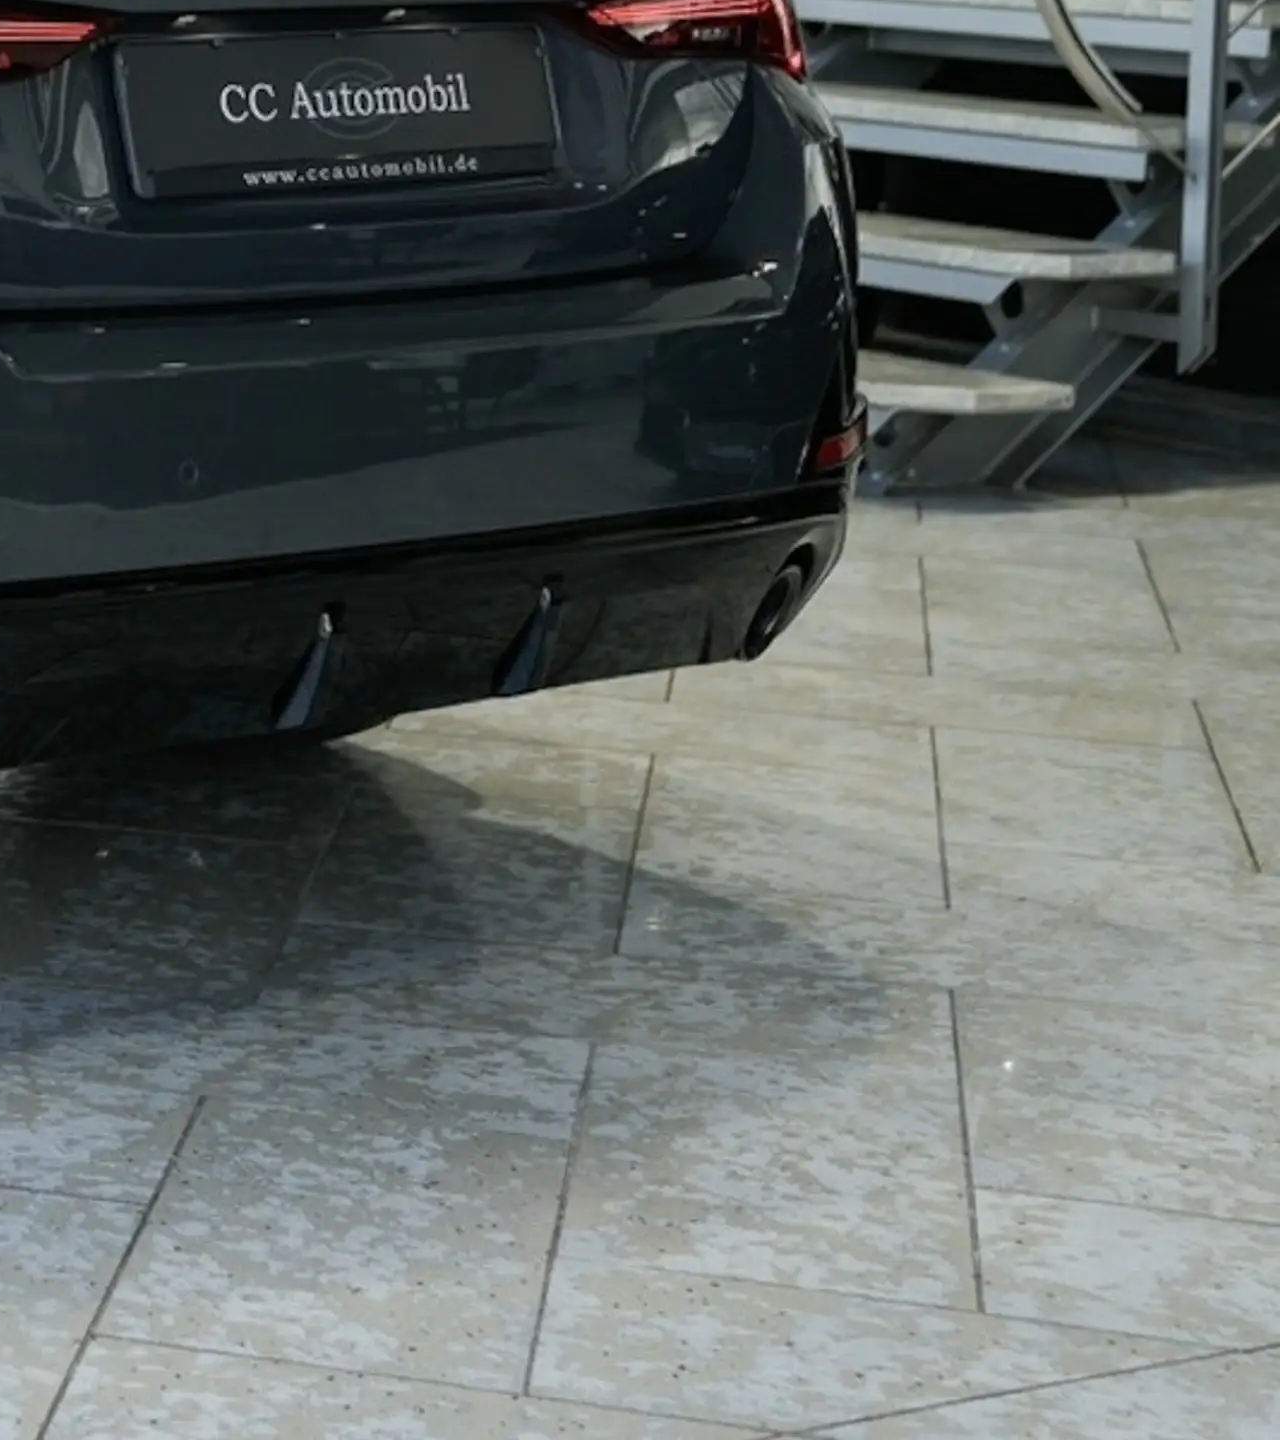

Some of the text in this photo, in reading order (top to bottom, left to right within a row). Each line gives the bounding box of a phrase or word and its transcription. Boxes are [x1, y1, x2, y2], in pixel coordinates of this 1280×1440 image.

[219, 72, 471, 124] CC Automobil
[243, 154, 478, 187] www.ccautomobil.de
